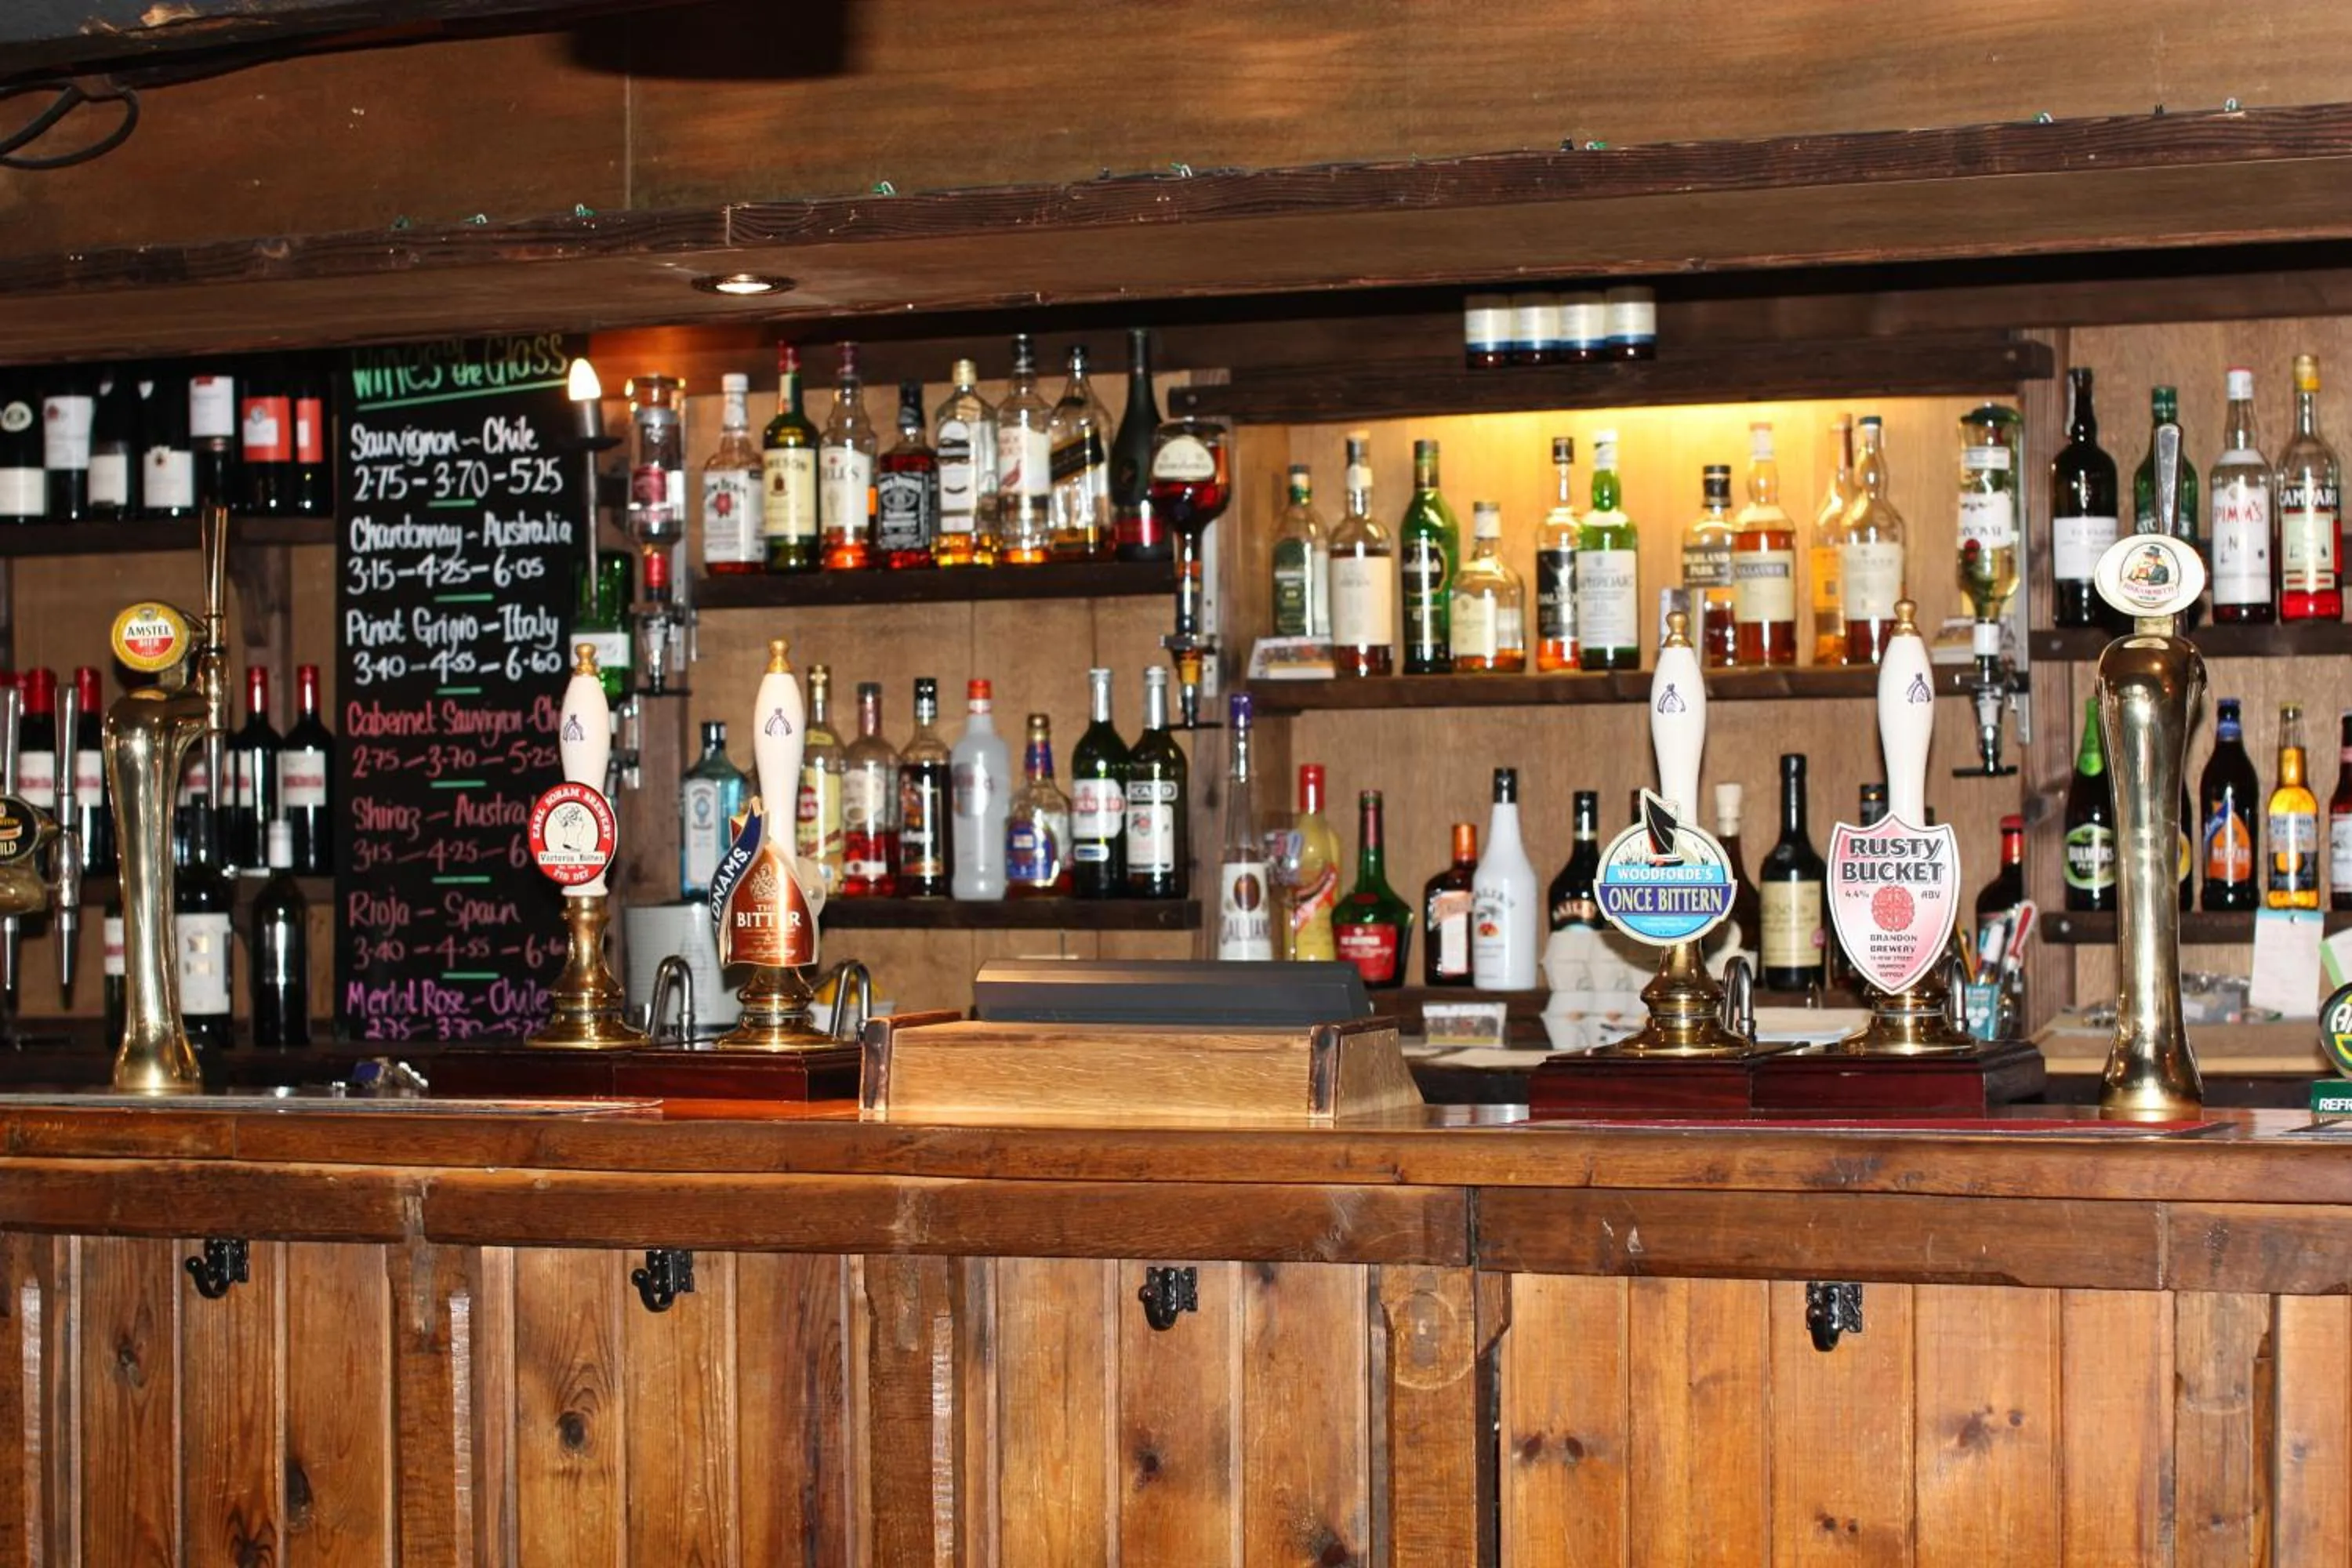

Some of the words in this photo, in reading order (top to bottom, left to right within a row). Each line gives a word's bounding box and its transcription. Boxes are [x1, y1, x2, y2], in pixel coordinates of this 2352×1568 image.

[483, 415, 539, 454] Chile
[354, 463, 408, 502] 2.75
[434, 459, 489, 499] 3.70
[2279, 488, 2337, 508] CAMARI
[483, 510, 572, 548] Australia
[347, 556, 395, 595] 3.15
[416, 553, 470, 588] 4.25
[493, 550, 545, 587] 6.05
[127, 625, 169, 637] AMSTEL
[346, 607, 406, 647] Pinot
[412, 606, 478, 657] Grigio
[498, 603, 558, 651] Italy
[354, 651, 406, 685] 3.40
[506, 646, 561, 681] 6.60
[1849, 837, 1944, 861] RUSTY
[1617, 867, 1714, 881] WOODFORDE'S
[1842, 862, 1944, 884] BUCKET
[348, 890, 410, 935] Rioja
[444, 891, 521, 931] Spain
[1608, 887, 1654, 913] ONCE
[1657, 887, 1723, 913] BITTERN
[737, 911, 801, 927] BITTR
